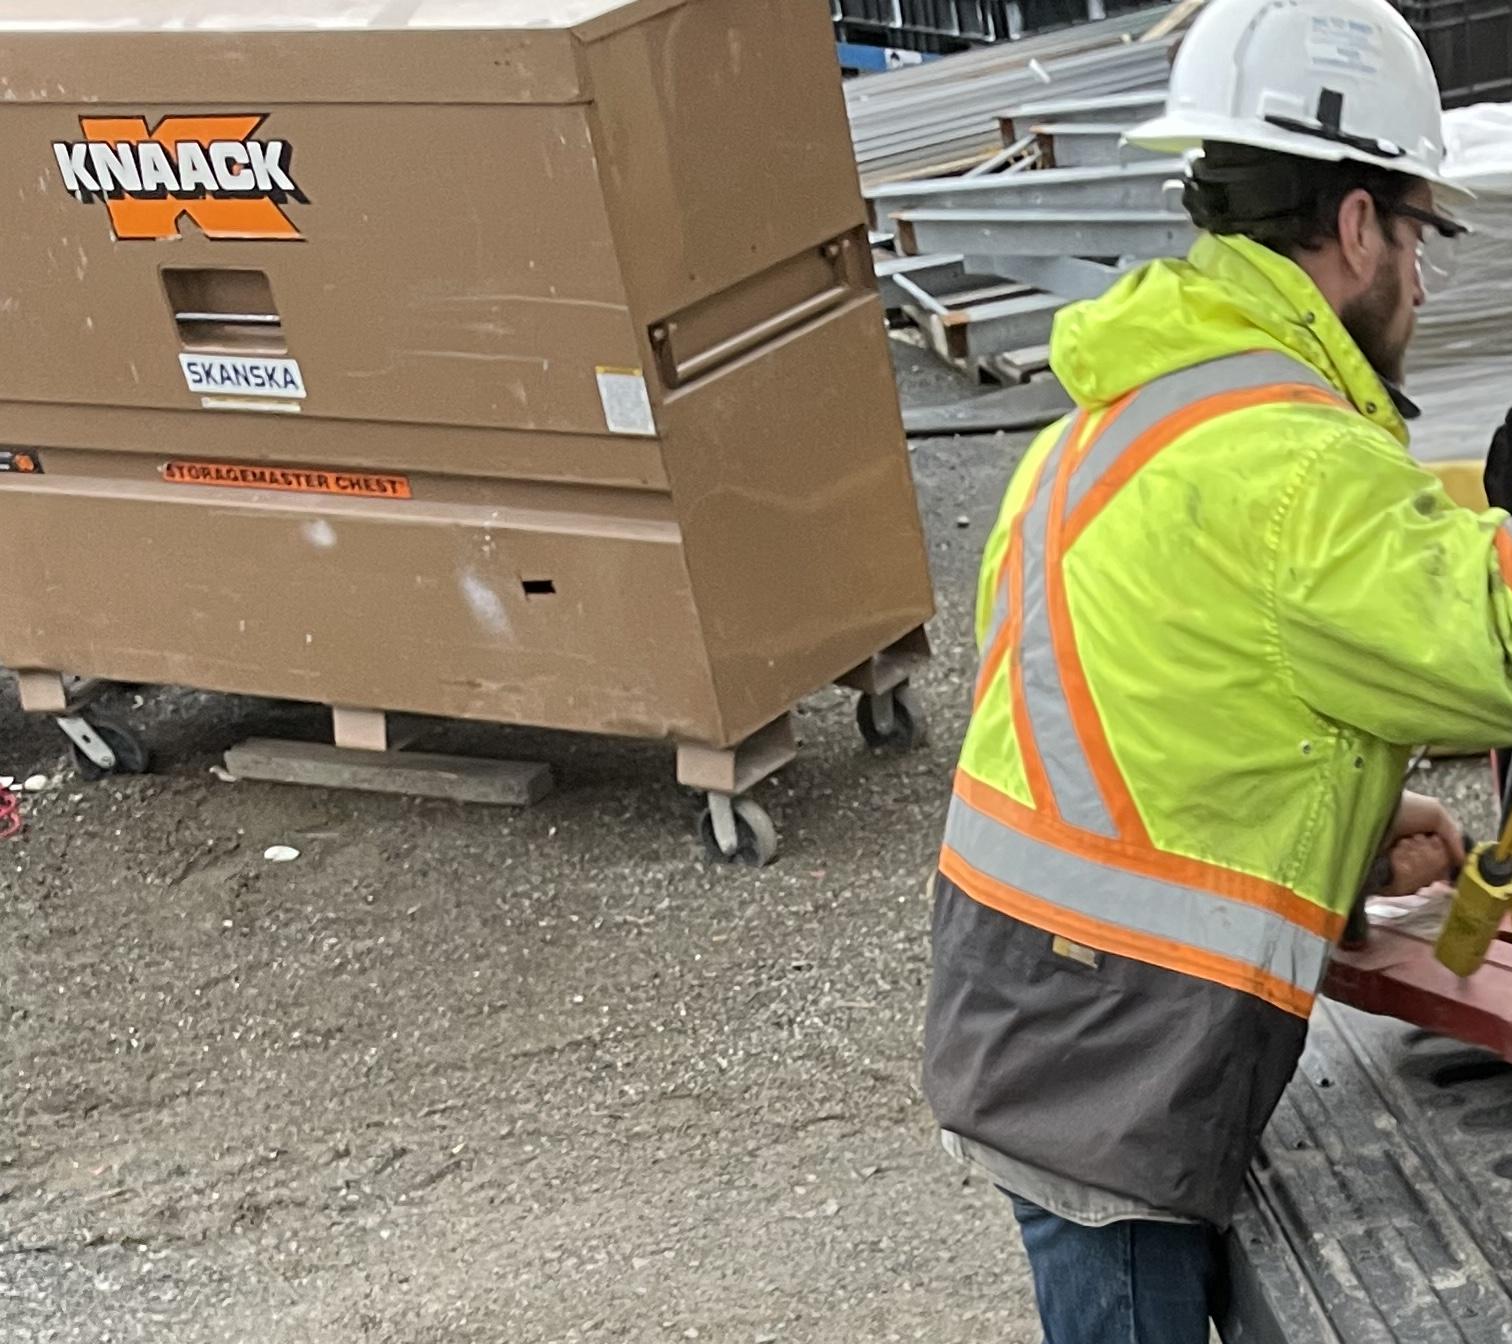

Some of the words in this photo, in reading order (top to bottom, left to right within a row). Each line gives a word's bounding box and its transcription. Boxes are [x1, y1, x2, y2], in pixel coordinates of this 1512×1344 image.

[52, 140, 304, 202] KNAACK
[187, 361, 299, 391] SKANSKA
[165, 463, 331, 490] STORAGEMASTER
[335, 476, 399, 495] CHEST
